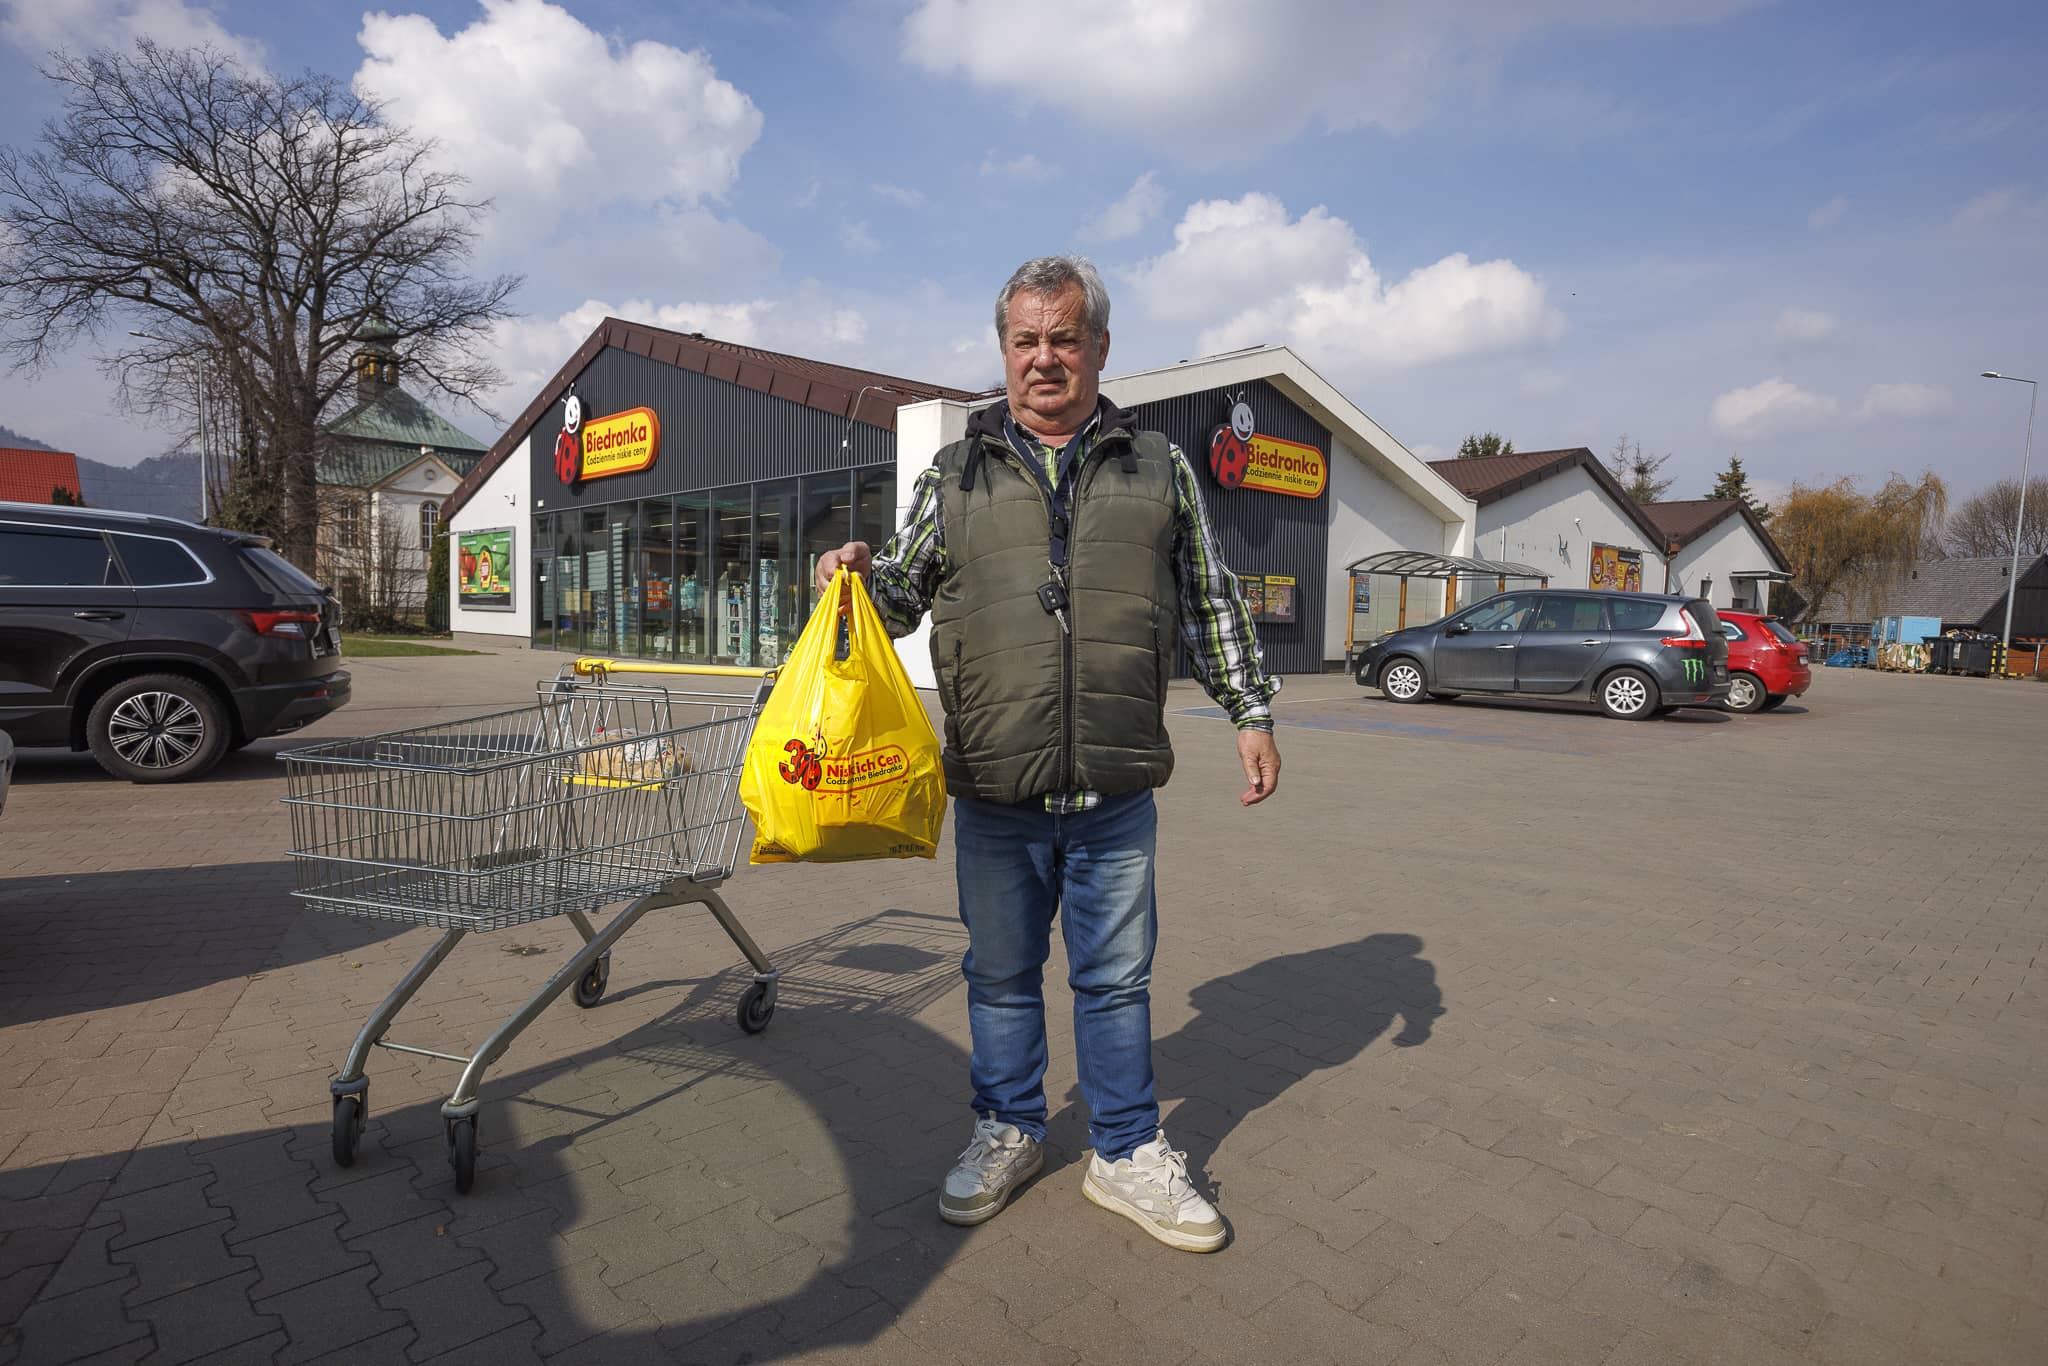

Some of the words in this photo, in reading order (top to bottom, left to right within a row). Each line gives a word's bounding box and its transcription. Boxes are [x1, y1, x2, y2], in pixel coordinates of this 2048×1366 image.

[586, 421, 647, 453] Biedronka
[586, 450, 616, 466] Codziennie
[616, 447, 632, 460] niskie
[633, 447, 647, 457] ceny
[1247, 443, 1319, 477] Biedronka
[1284, 473, 1303, 485] niskie
[1303, 479, 1319, 489] ceny
[878, 754, 901, 767] Cen
[868, 764, 903, 778] Biedronka
